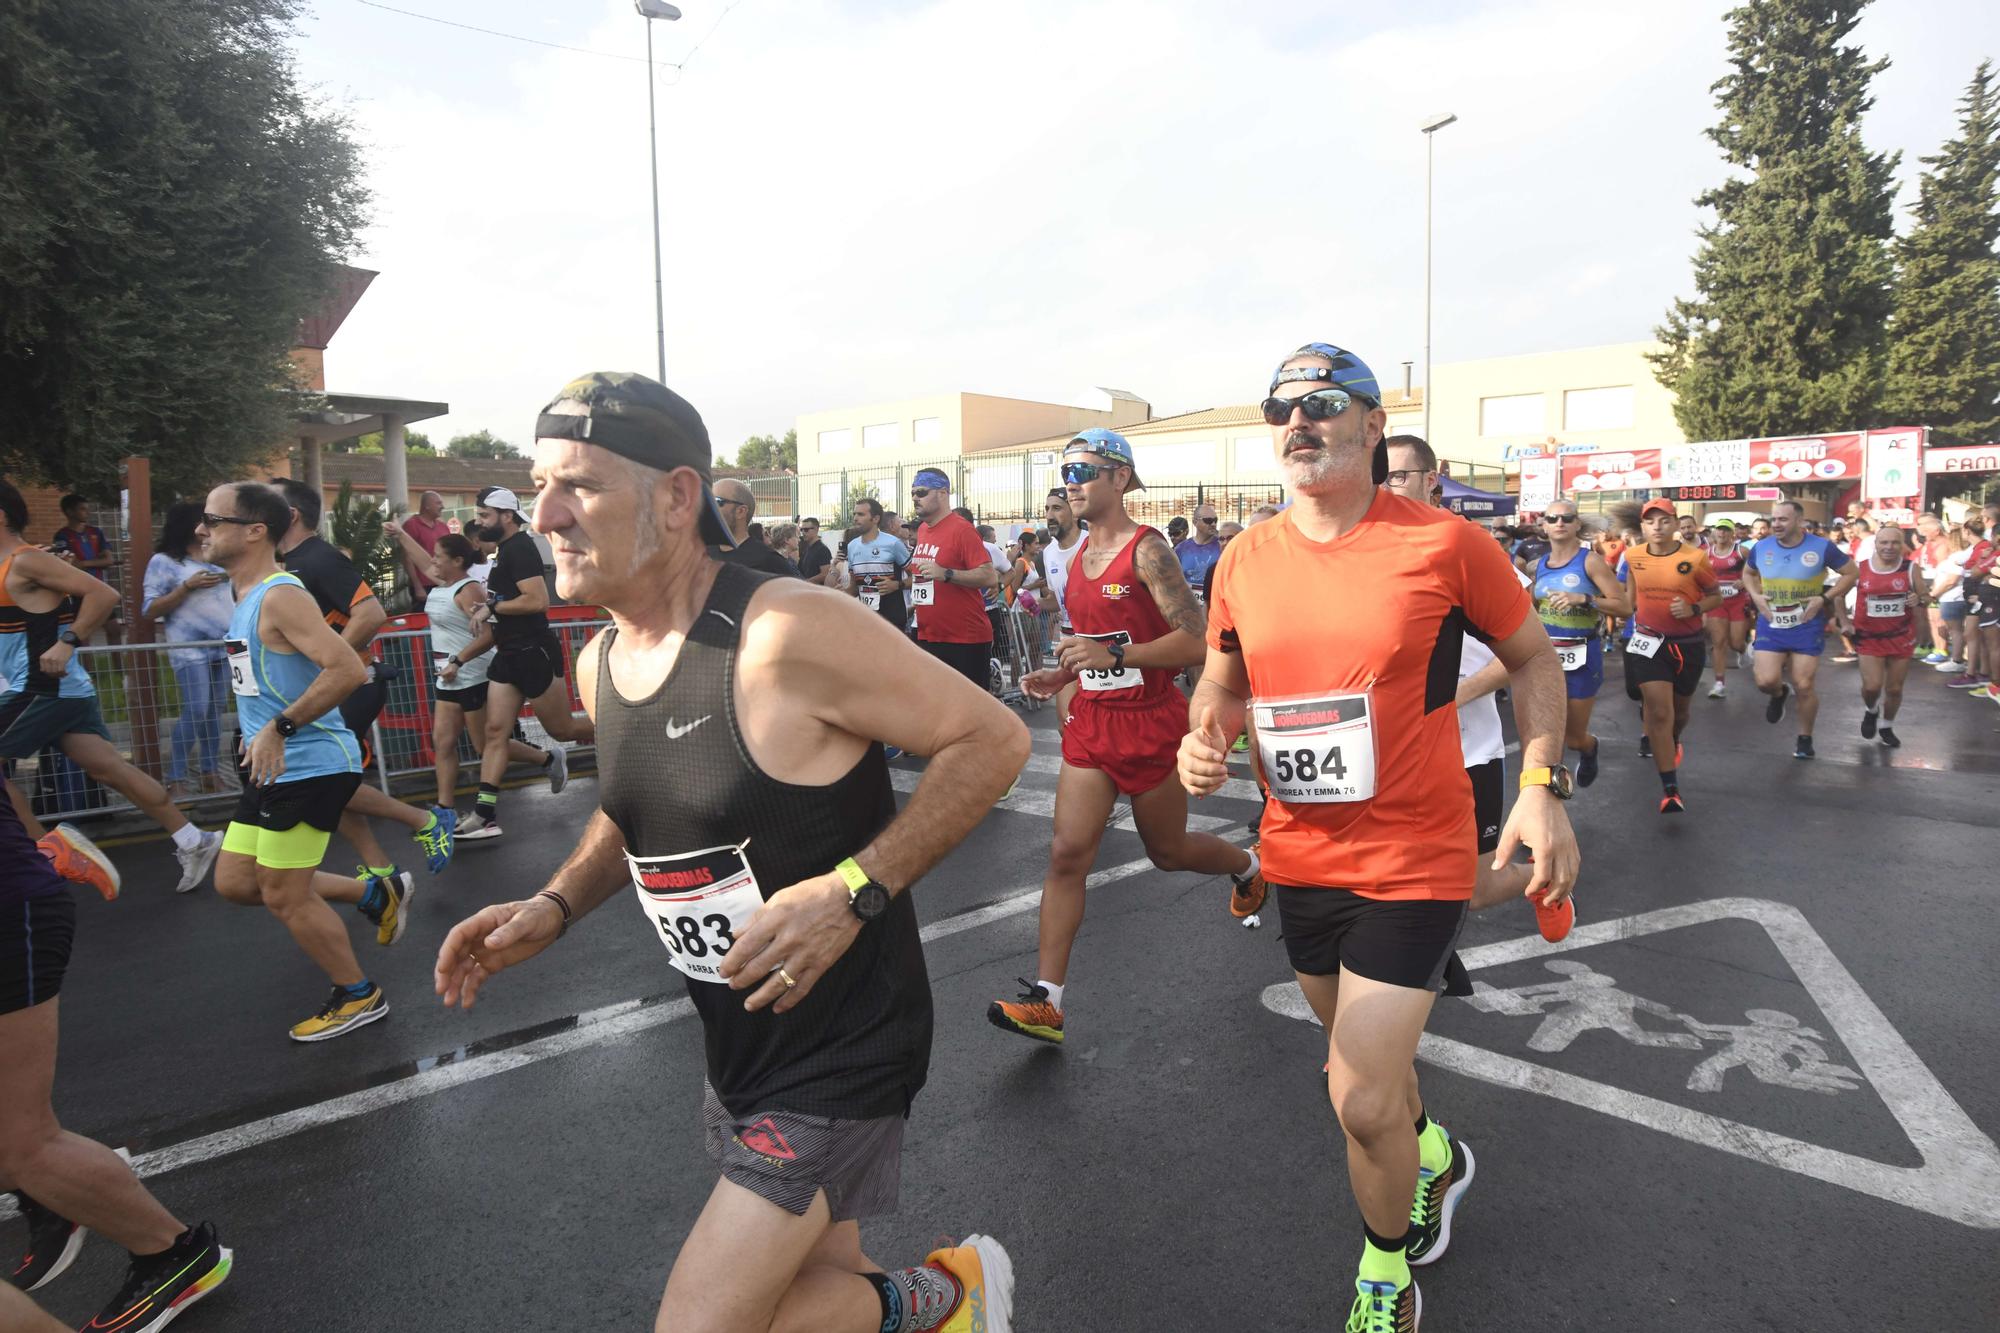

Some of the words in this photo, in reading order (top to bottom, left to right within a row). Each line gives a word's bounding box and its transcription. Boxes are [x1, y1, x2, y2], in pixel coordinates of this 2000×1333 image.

[1679, 486, 1737, 499] 0:00:16
[1875, 603, 1900, 613] 592
[1275, 746, 1347, 782] 584
[1305, 788, 1312, 796] Y
[1314, 787, 1341, 796] EMMA
[1343, 786, 1356, 795] 76
[658, 913, 736, 957] 583
[687, 963, 716, 975] PARRA
